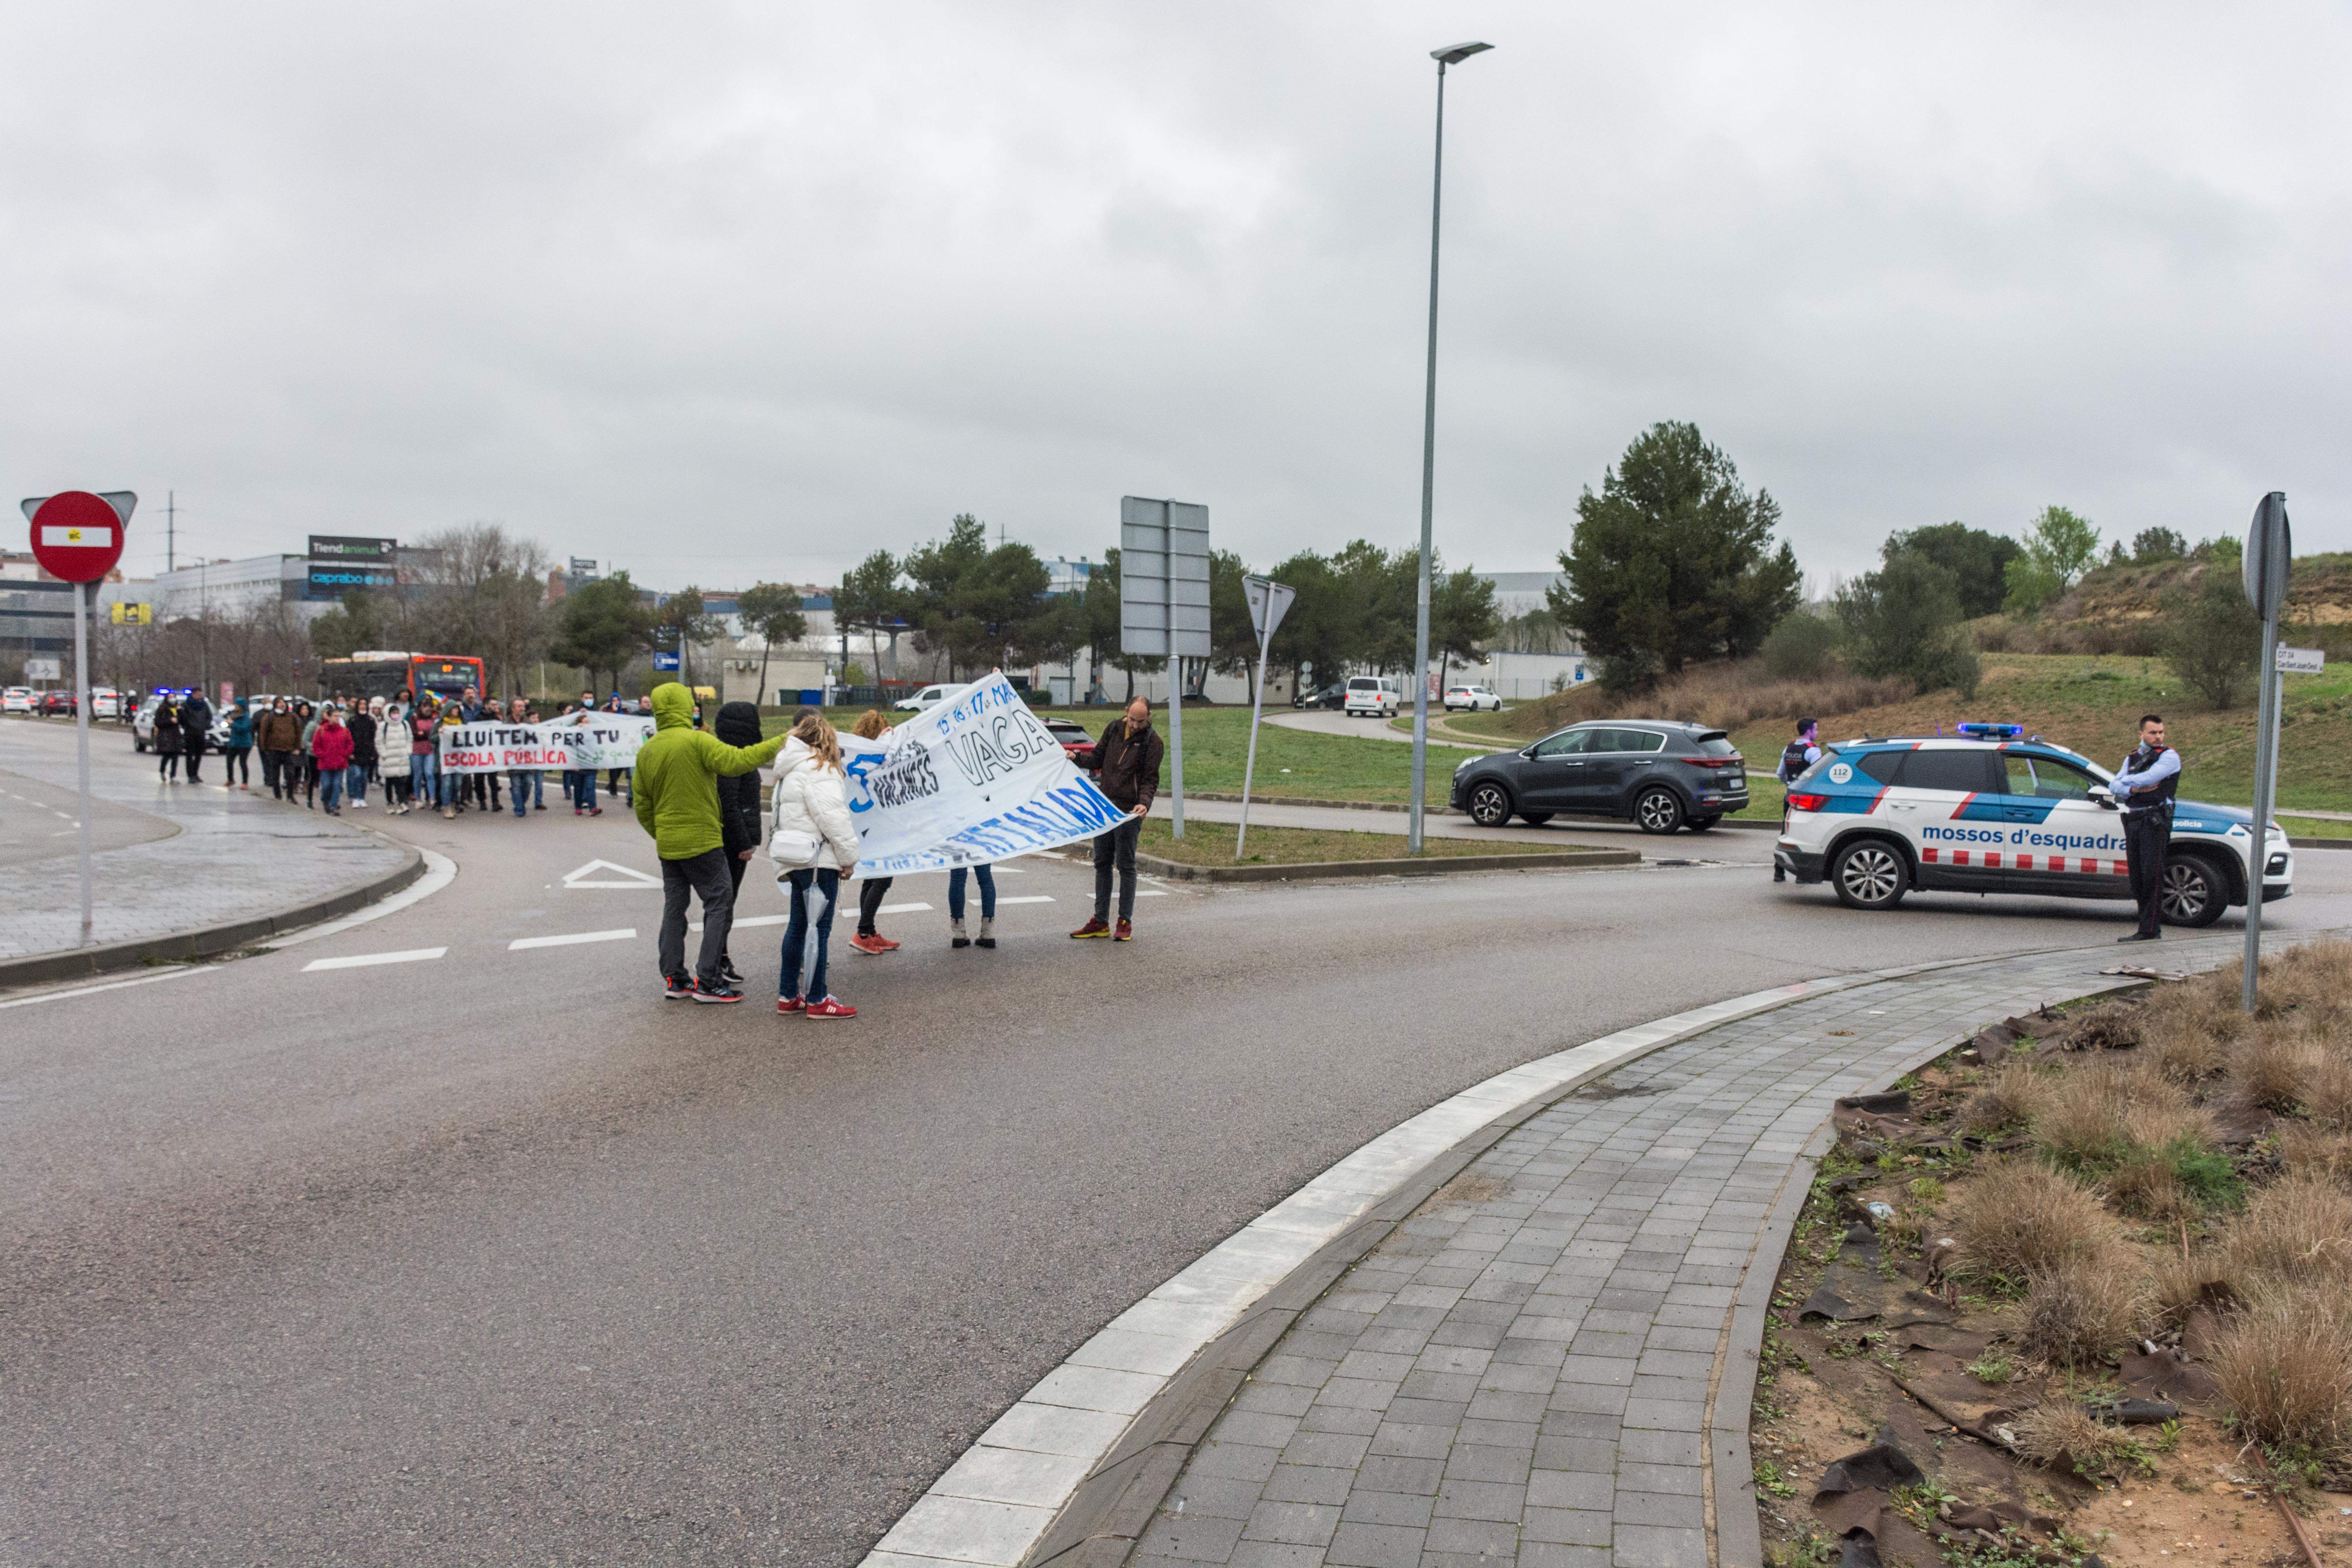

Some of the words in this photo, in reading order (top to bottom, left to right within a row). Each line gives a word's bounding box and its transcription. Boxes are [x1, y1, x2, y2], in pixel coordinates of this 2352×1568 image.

[311, 572, 363, 585] caprabo
[971, 691, 983, 715] 17
[452, 729, 538, 748] LLUÍTEM
[552, 732, 584, 746] PER
[593, 730, 619, 745] TU
[945, 710, 1054, 786] VAGA
[444, 750, 496, 766] ESCOLA
[504, 745, 567, 766] PÚBLICA
[873, 754, 939, 808] VACANCES
[1923, 826, 2004, 843] mossos
[2011, 829, 2127, 851] d'esquadra
